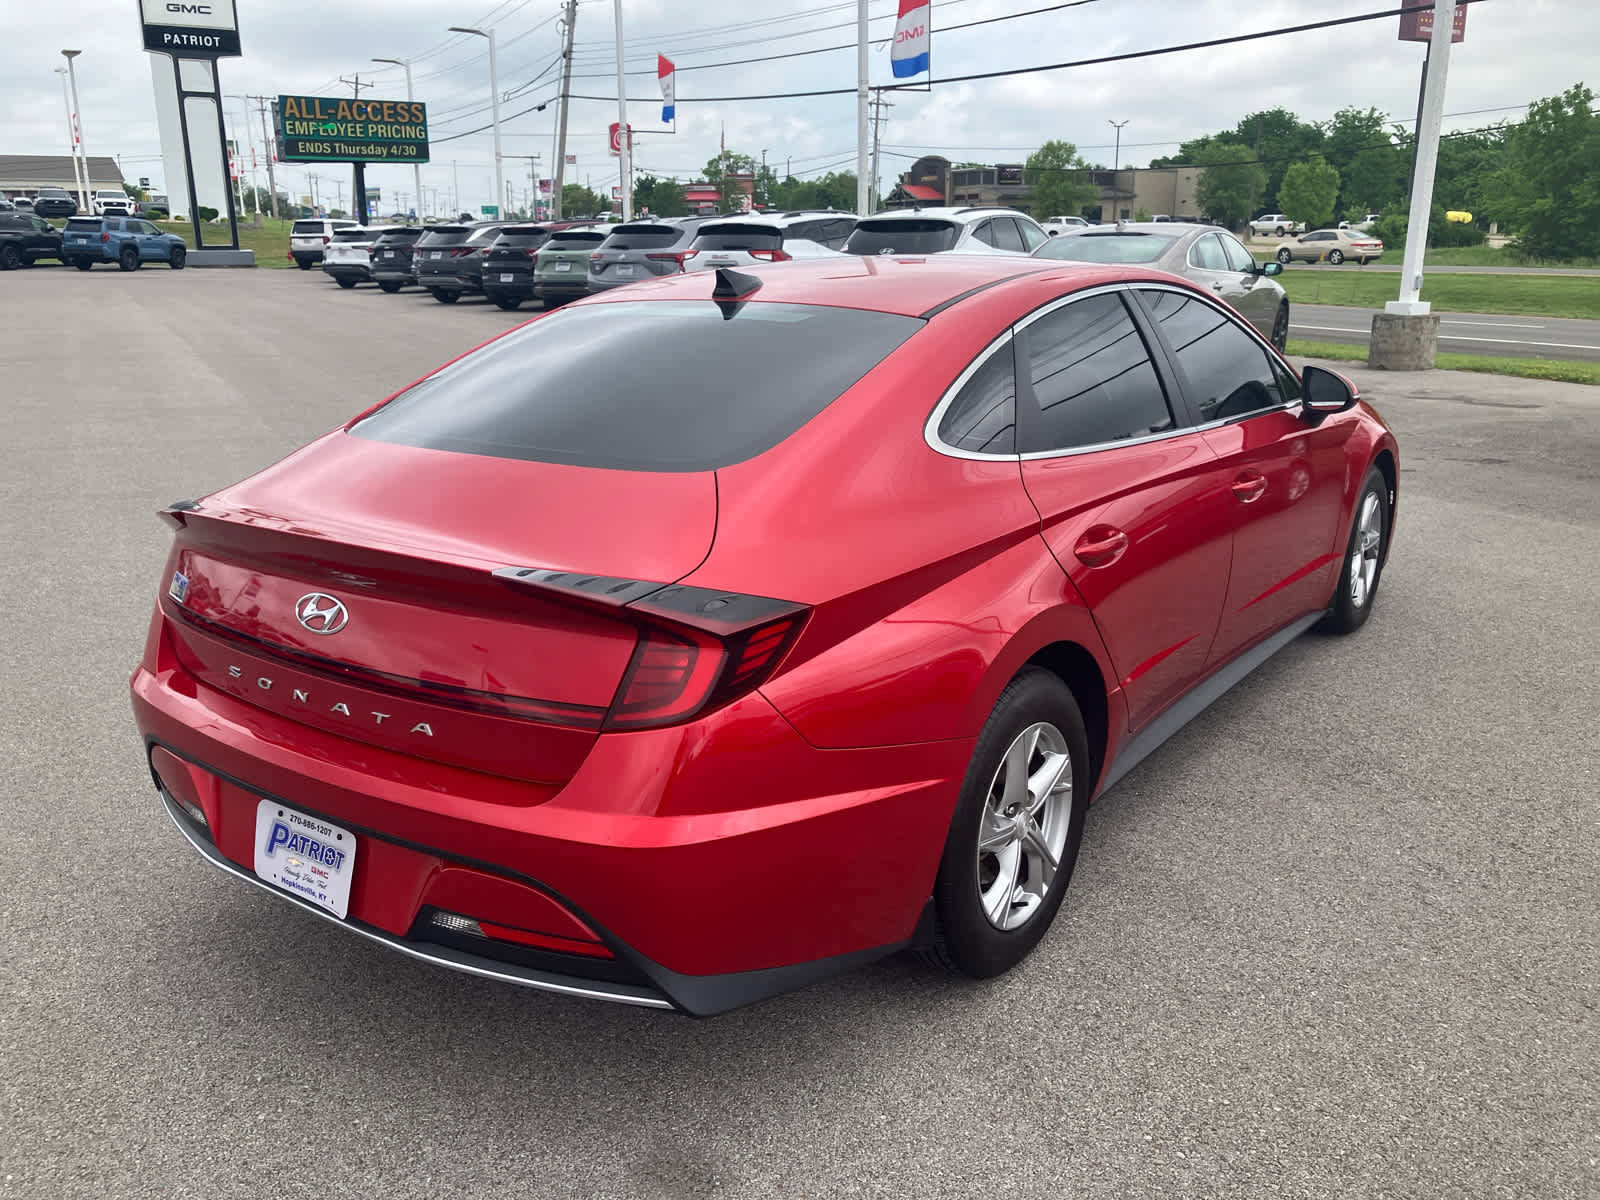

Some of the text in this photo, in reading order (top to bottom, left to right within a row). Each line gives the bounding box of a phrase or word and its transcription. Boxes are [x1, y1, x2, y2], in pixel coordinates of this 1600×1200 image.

[166, 3, 212, 15] GMC
[163, 33, 220, 48] PATRIOT
[284, 97, 425, 124] ALL-ACCESS
[368, 124, 426, 139] PRICING
[298, 141, 417, 157] ENDS Thursday 4/30
[228, 665, 433, 736] SONATA
[289, 814, 333, 837] 270-886-1207
[267, 822, 345, 870] PATRIOT
[311, 866, 329, 880] GMC
[318, 892, 328, 902] KY
